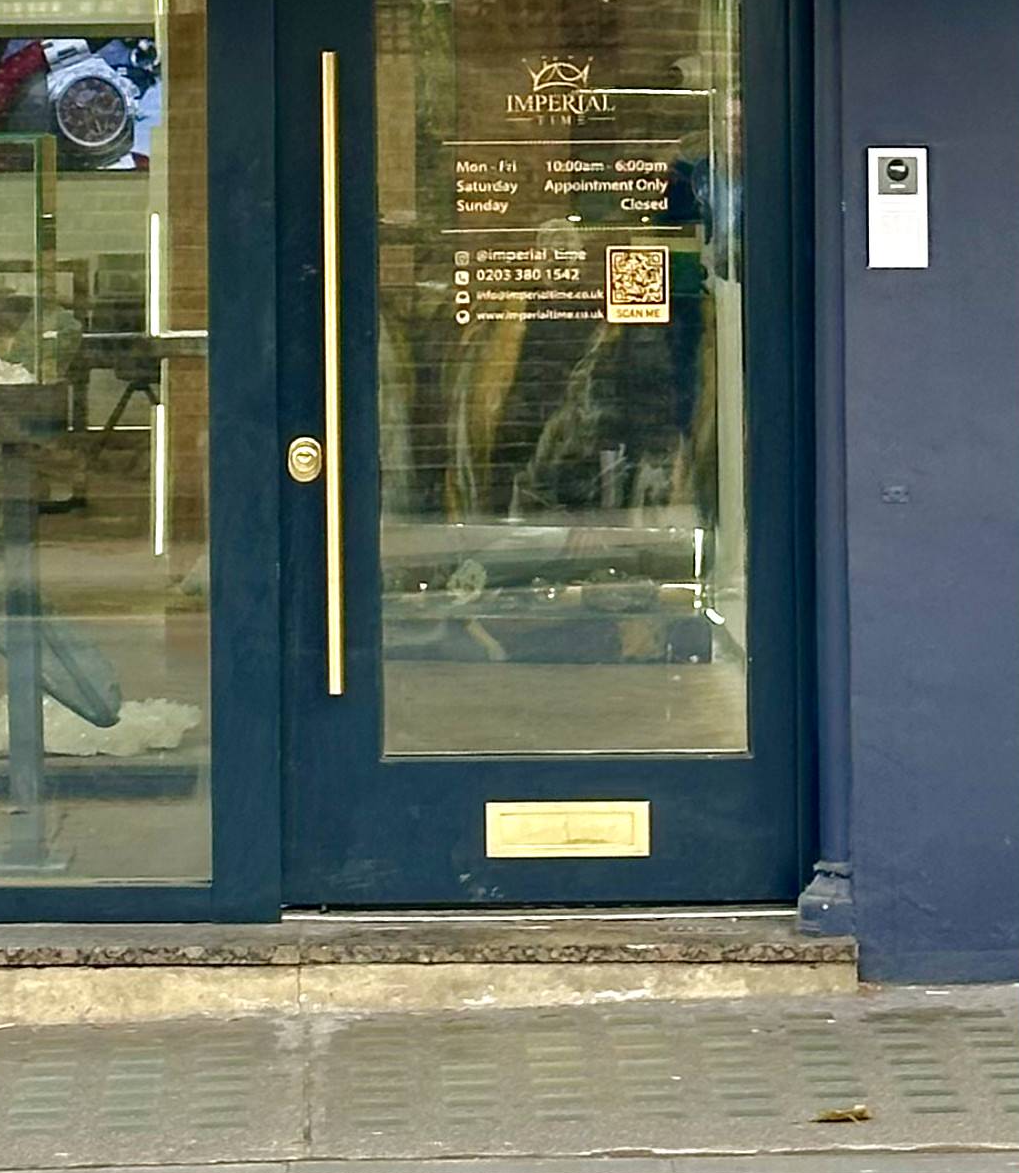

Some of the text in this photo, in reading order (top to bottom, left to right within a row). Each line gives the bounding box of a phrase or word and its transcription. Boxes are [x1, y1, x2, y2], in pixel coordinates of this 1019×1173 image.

[507, 93, 616, 115] IMPERIAL
[538, 115, 586, 126] TIME
[456, 160, 488, 173] Mon
[499, 159, 517, 173] Fri
[546, 160, 605, 173] 10:00am
[614, 160, 668, 175] 6:00pm
[456, 179, 669, 195] Saturday Appointment Only
[456, 197, 669, 214] Sunday Closed
[476, 268, 581, 281] 0203 380 1542
[476, 289, 605, 303] info@imperialtime.co.uk
[476, 309, 605, 323] www.imperialtime.co.uk
[616, 308, 661, 319] SCAN ME
